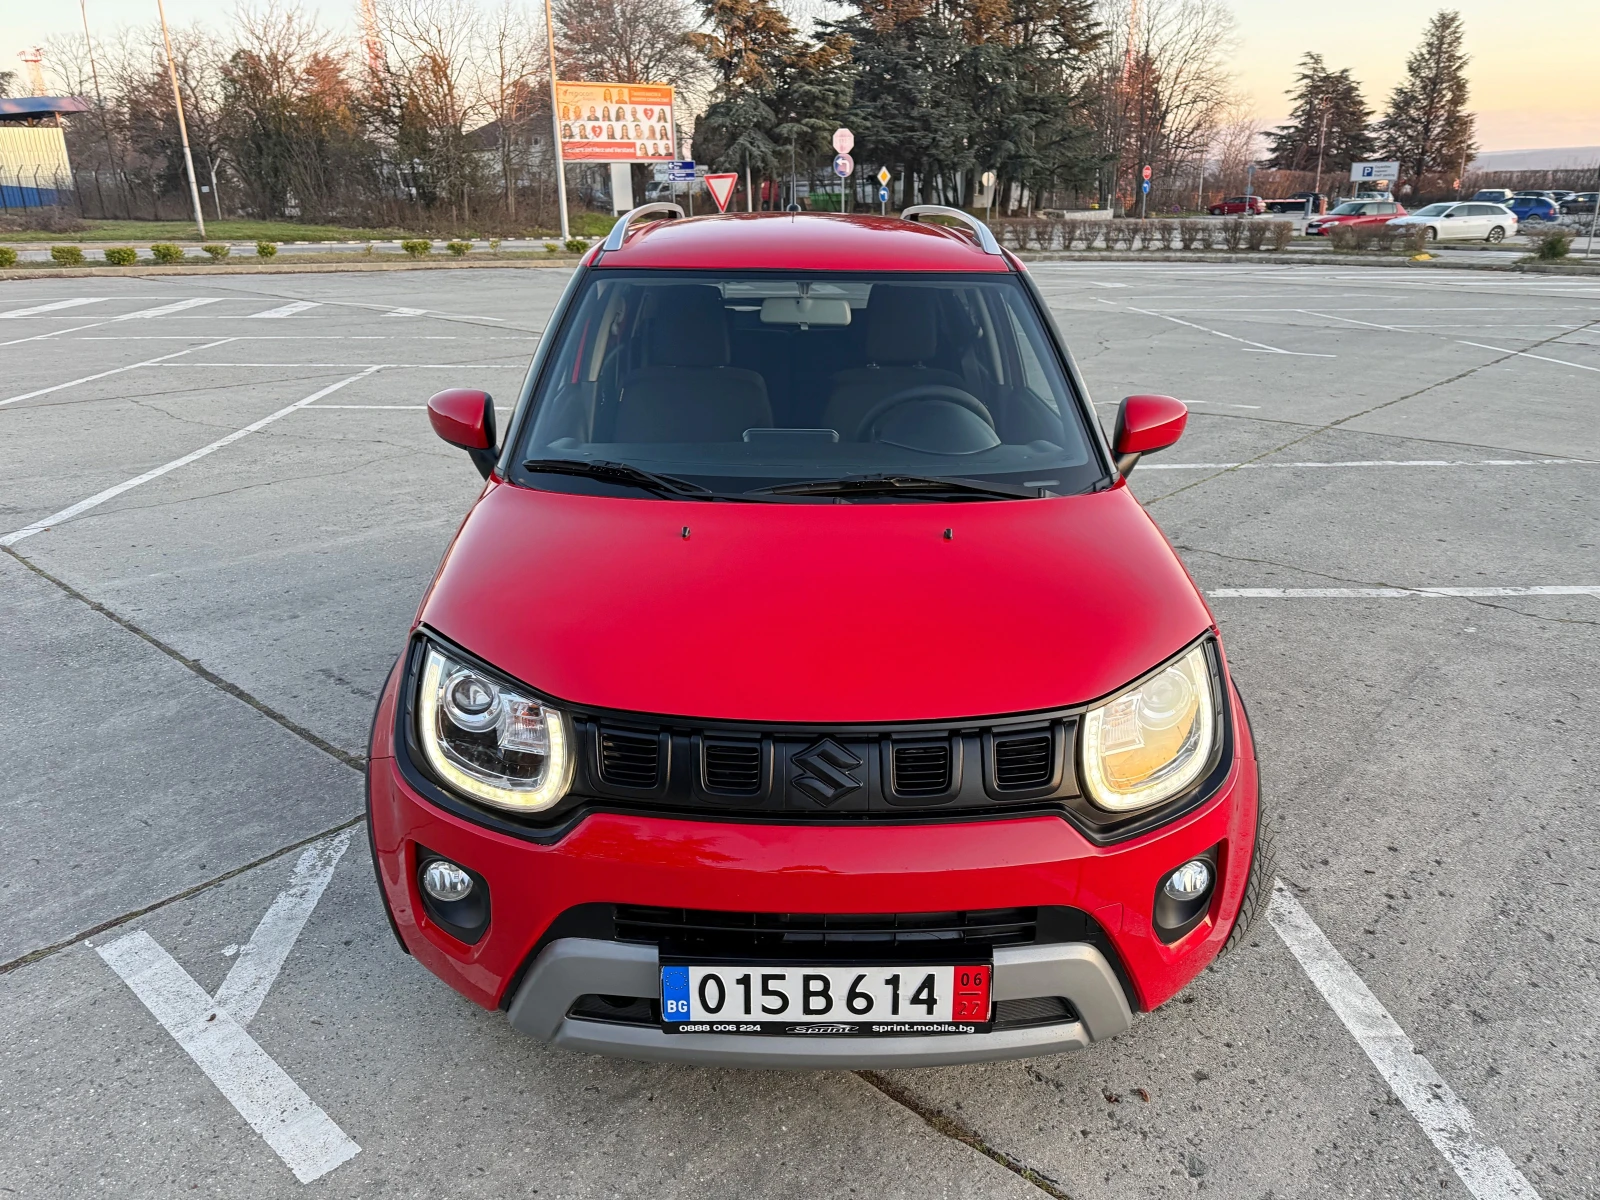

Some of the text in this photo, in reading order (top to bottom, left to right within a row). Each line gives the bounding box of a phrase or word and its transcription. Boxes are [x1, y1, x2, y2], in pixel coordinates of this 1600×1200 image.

[1364, 167, 1372, 176] P
[961, 973, 983, 987] 06
[667, 1001, 688, 1013] BG
[957, 1001, 981, 1015] 27
[872, 1024, 975, 1034] sprint.mobile.bg
